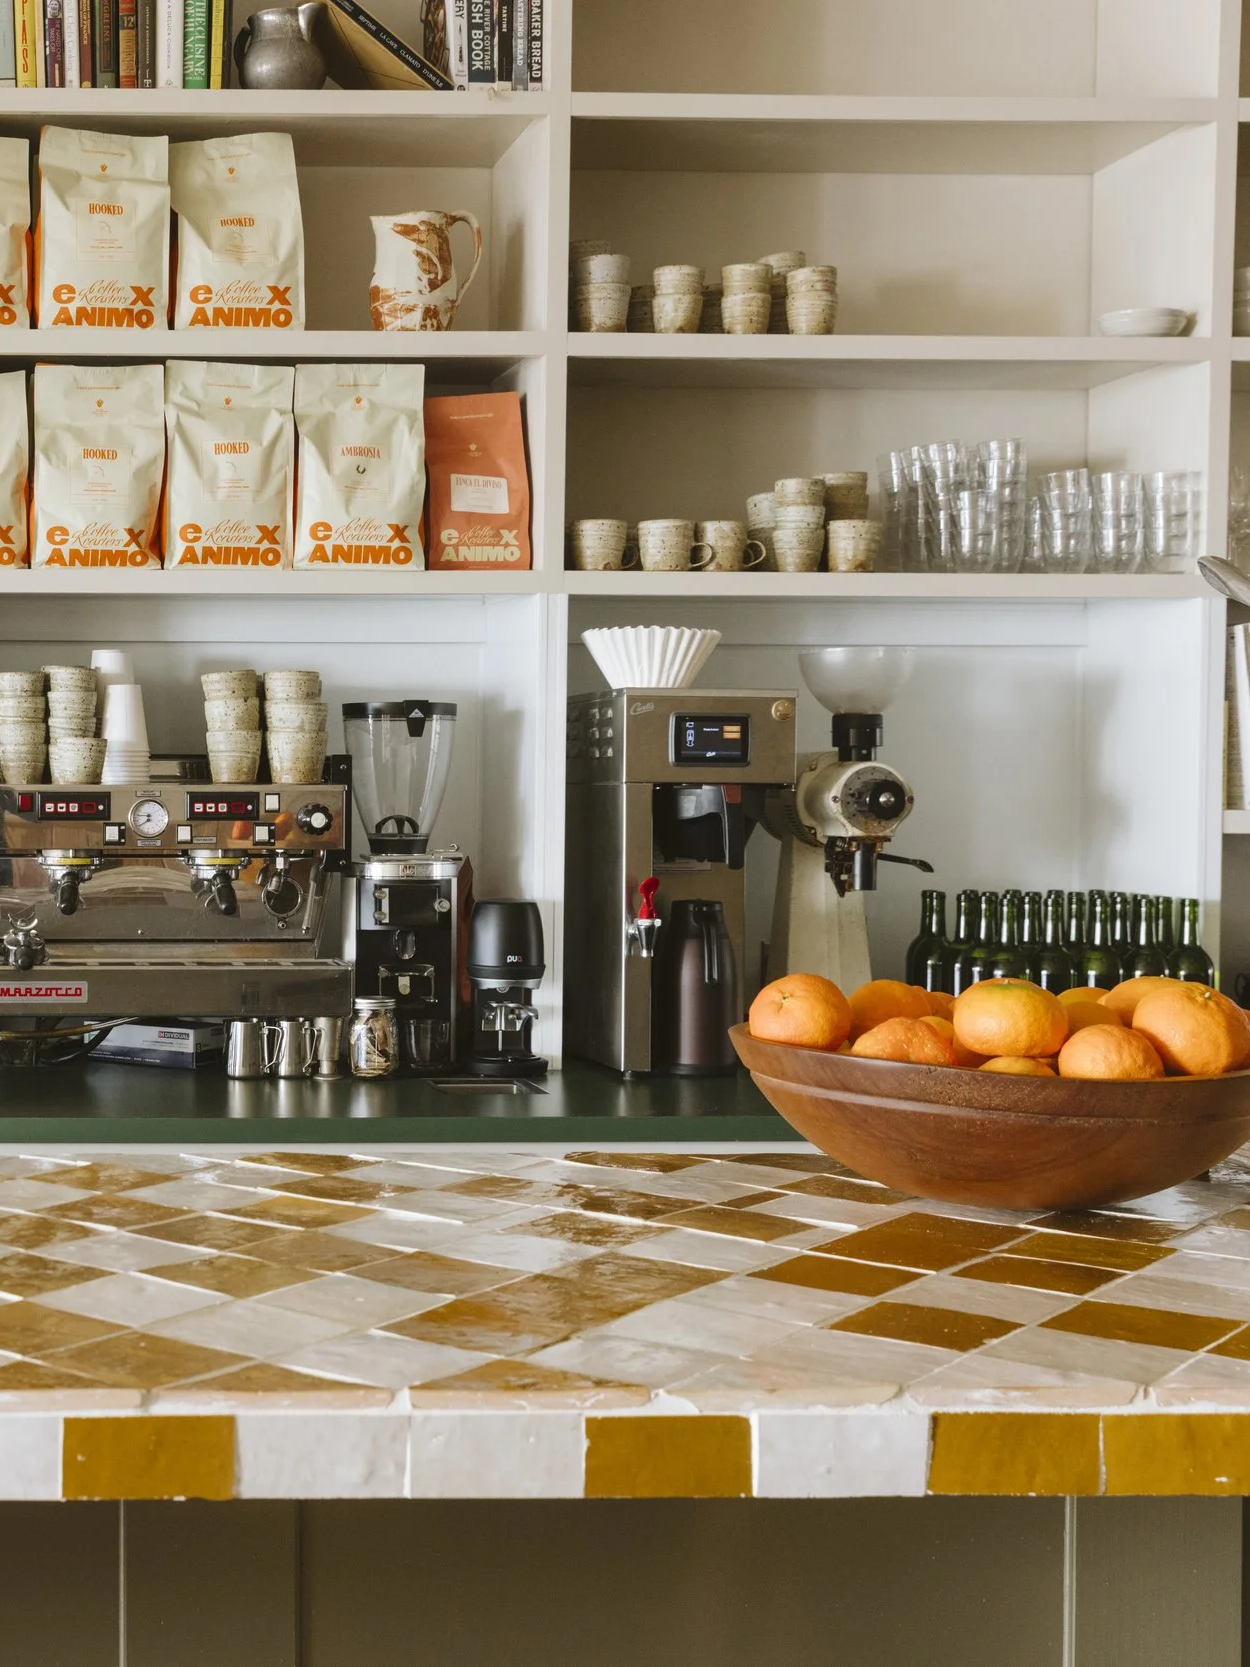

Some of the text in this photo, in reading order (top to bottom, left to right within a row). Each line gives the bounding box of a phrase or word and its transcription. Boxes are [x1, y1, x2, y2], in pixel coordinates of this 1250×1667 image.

[184, 0, 195, 17] OF
[195, 1, 206, 26] THE
[123, 16, 134, 27] 12
[183, 18, 194, 75] HUNGARY
[358, 14, 377, 31] SEPTIME
[386, 37, 398, 49] CAVE
[399, 49, 421, 69] CLAMATO
[531, 0, 541, 78] BAKER BREAD
[194, 27, 206, 76] CUISINE
[472, 30, 483, 70] BOOK
[89, 203, 123, 215] HOOKED
[220, 217, 255, 227] HOOKED
[52, 306, 155, 329] ANIMO
[189, 307, 293, 328] ANIMO
[83, 448, 117, 460] HOOKED
[214, 442, 249, 455] HOOKED
[341, 446, 381, 459] AMBROSIA
[45, 548, 149, 567] ANIMO
[178, 546, 281, 566] ANIMO
[308, 544, 413, 565] ANIMO
[440, 546, 520, 562] ANIMO
[158, 1031, 189, 1040] INDIVIDUAL
